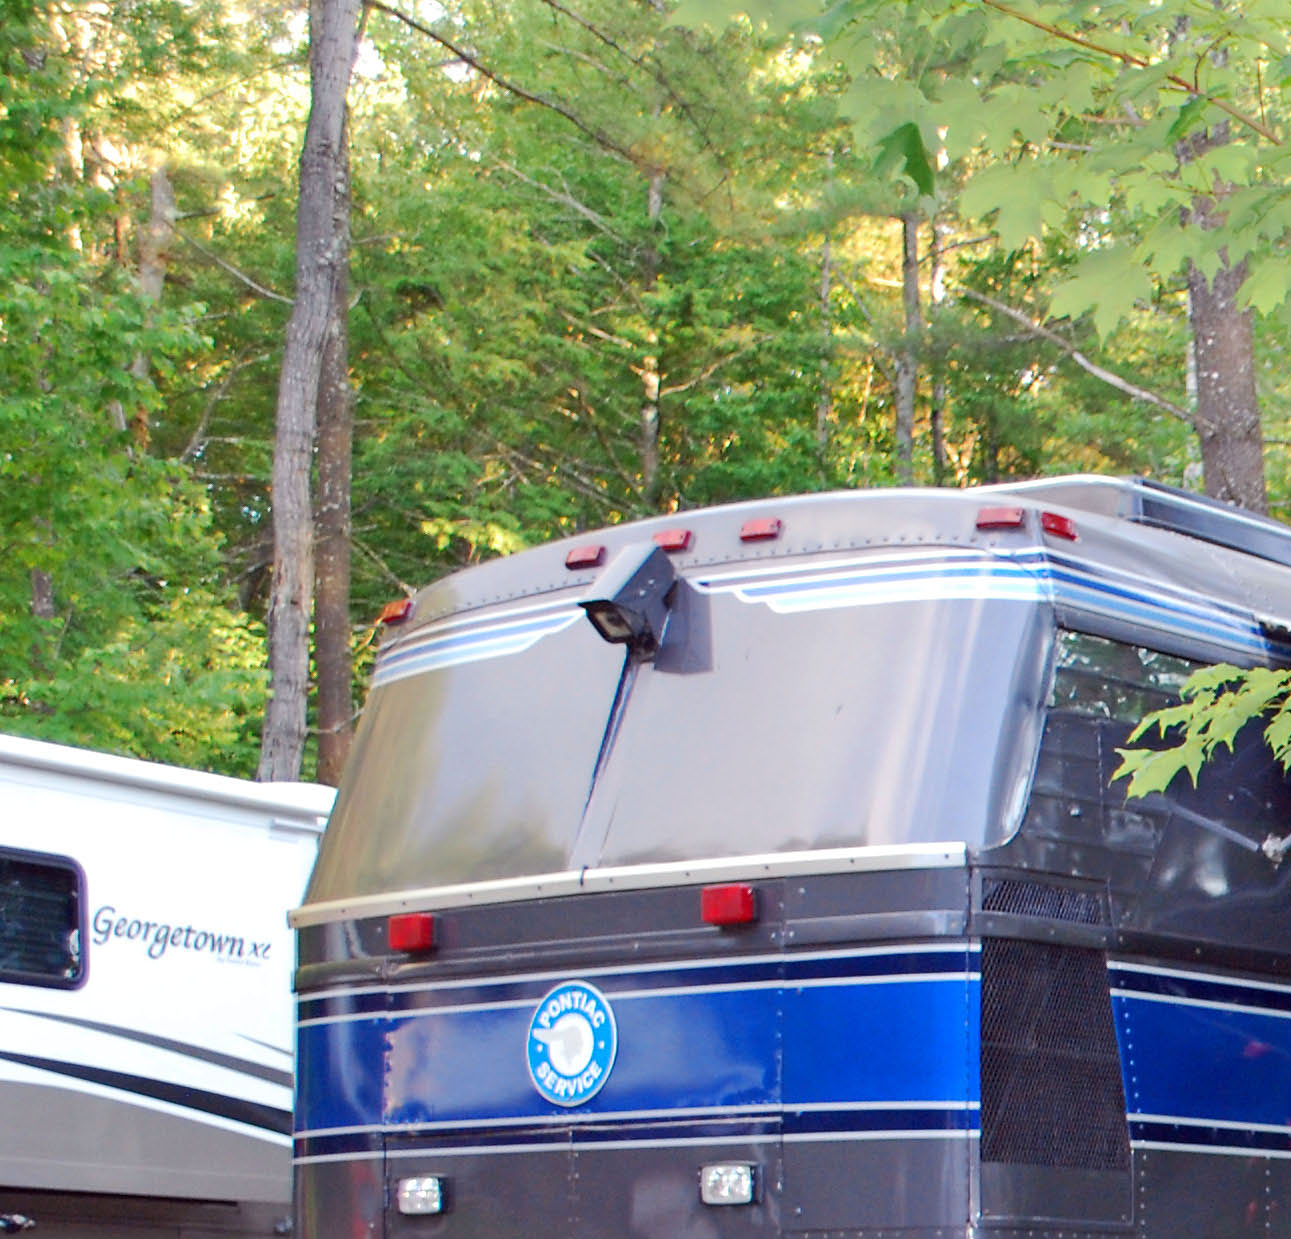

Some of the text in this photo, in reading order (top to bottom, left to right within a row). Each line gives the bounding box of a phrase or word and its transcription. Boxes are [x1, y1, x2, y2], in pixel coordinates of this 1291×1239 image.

[93, 905, 244, 960] Georgetown
[540, 991, 605, 1028] PONTIAC
[537, 1061, 602, 1097] SERVICE
